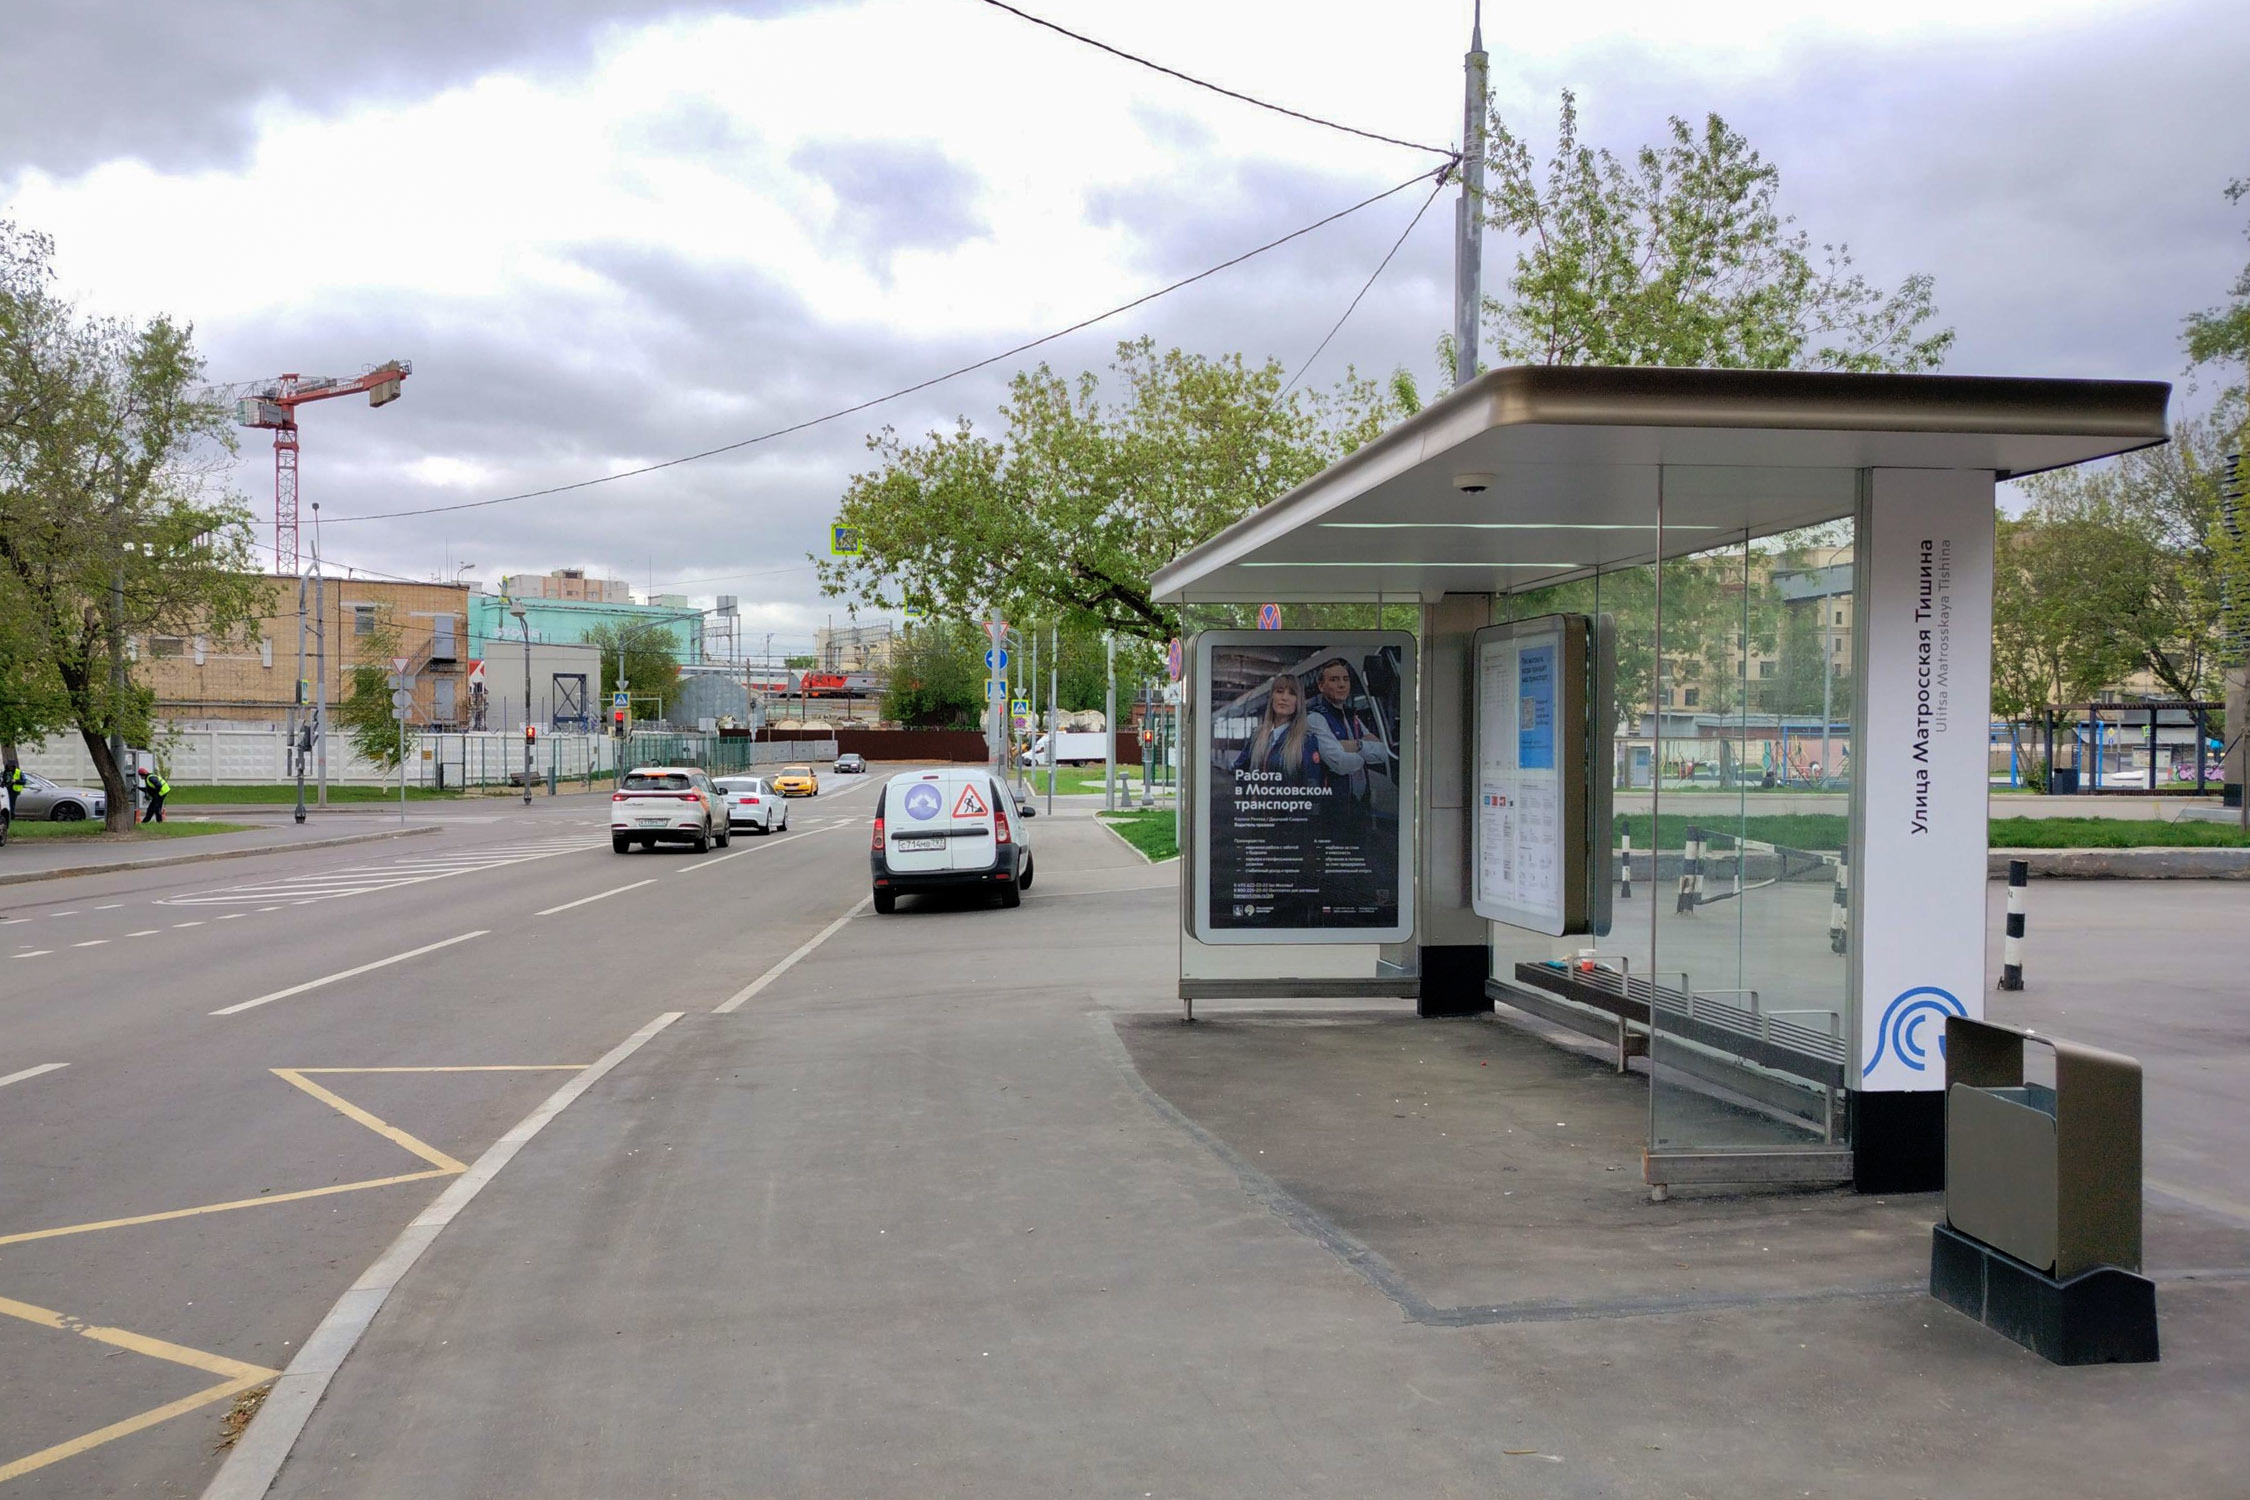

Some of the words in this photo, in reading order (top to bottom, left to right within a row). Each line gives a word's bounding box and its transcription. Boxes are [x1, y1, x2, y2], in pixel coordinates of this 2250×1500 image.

[1915, 539, 1933, 623] Тишина
[1938, 539, 1951, 592] Tishina
[1937, 595, 1952, 687] Matrosskaya
[1912, 629, 1933, 763] Матросская
[1935, 691, 1948, 733] Ulitsa
[1235, 769, 1282, 781] Работа
[1235, 786, 1243, 796] в
[1245, 783, 1333, 796] Московском
[1911, 769, 1931, 834] Улица
[1234, 800, 1313, 812] транспорте
